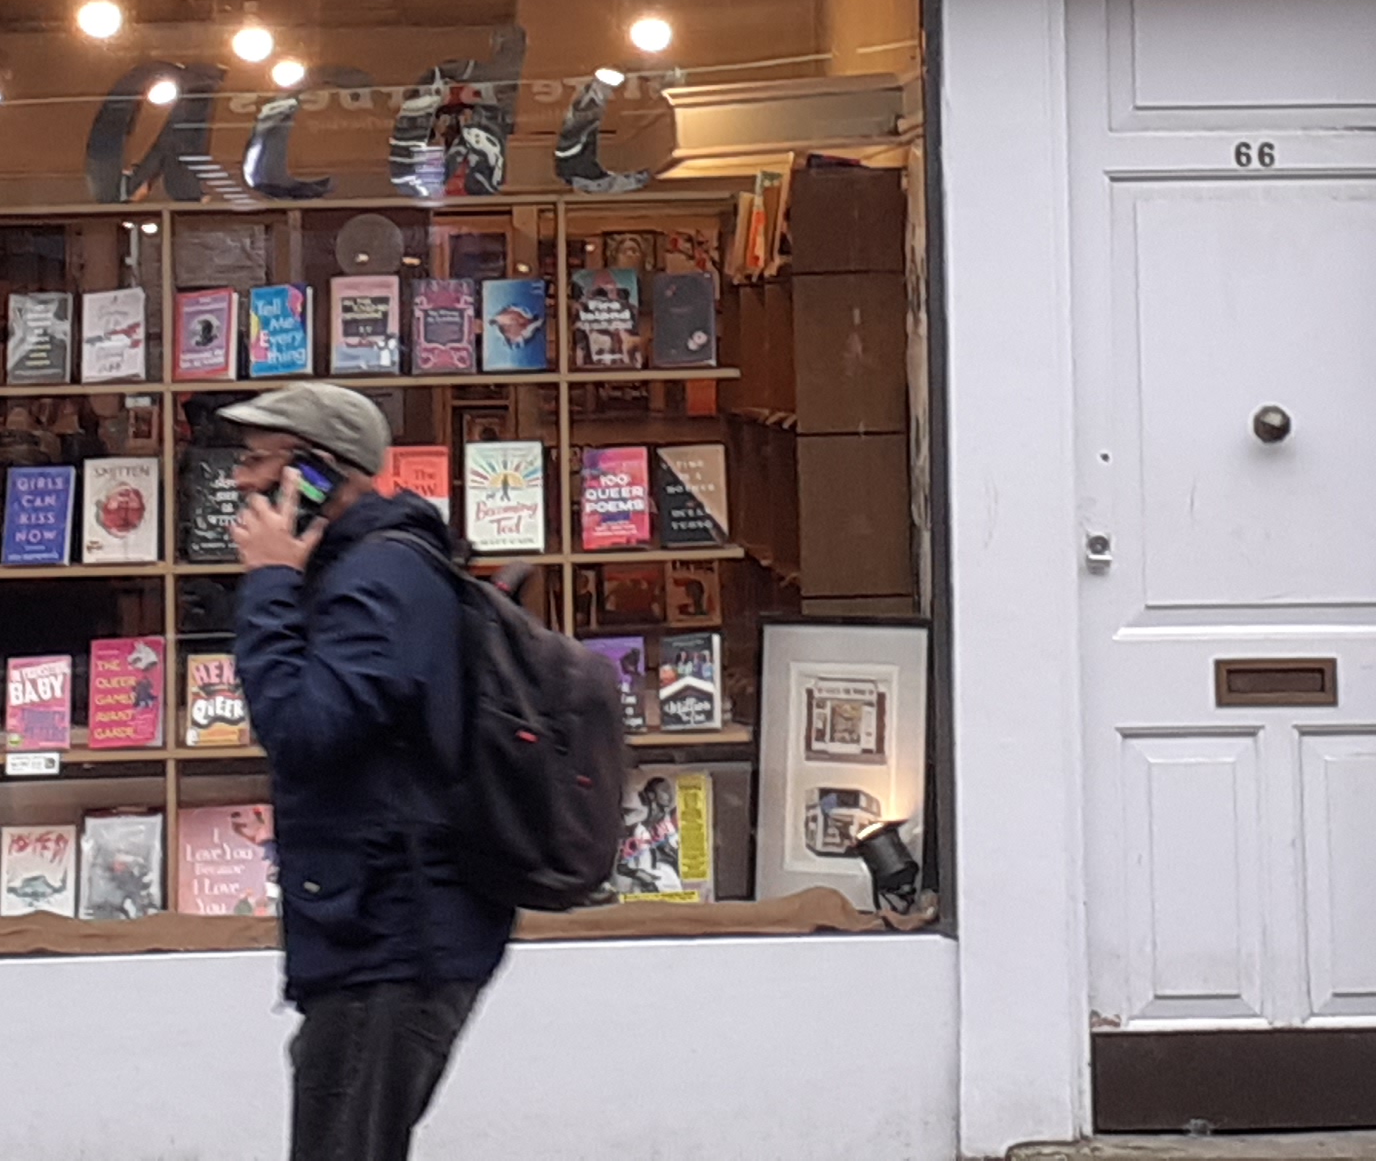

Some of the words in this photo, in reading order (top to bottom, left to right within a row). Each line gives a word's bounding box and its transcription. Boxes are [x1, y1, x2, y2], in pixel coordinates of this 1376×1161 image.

[1234, 141, 1276, 168] 66
[256, 297, 281, 316] Tell
[270, 316, 296, 331] Me
[259, 329, 304, 347] Every
[268, 347, 305, 365] thing
[94, 465, 151, 478] SMITTEN
[414, 468, 435, 480] The
[16, 477, 64, 492] GIRLS
[599, 473, 631, 487] 100
[585, 485, 644, 500] QUEER
[22, 494, 56, 508] CAN
[585, 498, 645, 513] POEMS
[476, 500, 539, 521] Becoming
[489, 515, 523, 535] Ted
[15, 529, 57, 543] NOW
[96, 660, 121, 672] THE
[8, 675, 64, 706] BABY
[185, 842, 222, 861] Love
[223, 842, 254, 860] You
[204, 877, 240, 895] Love
